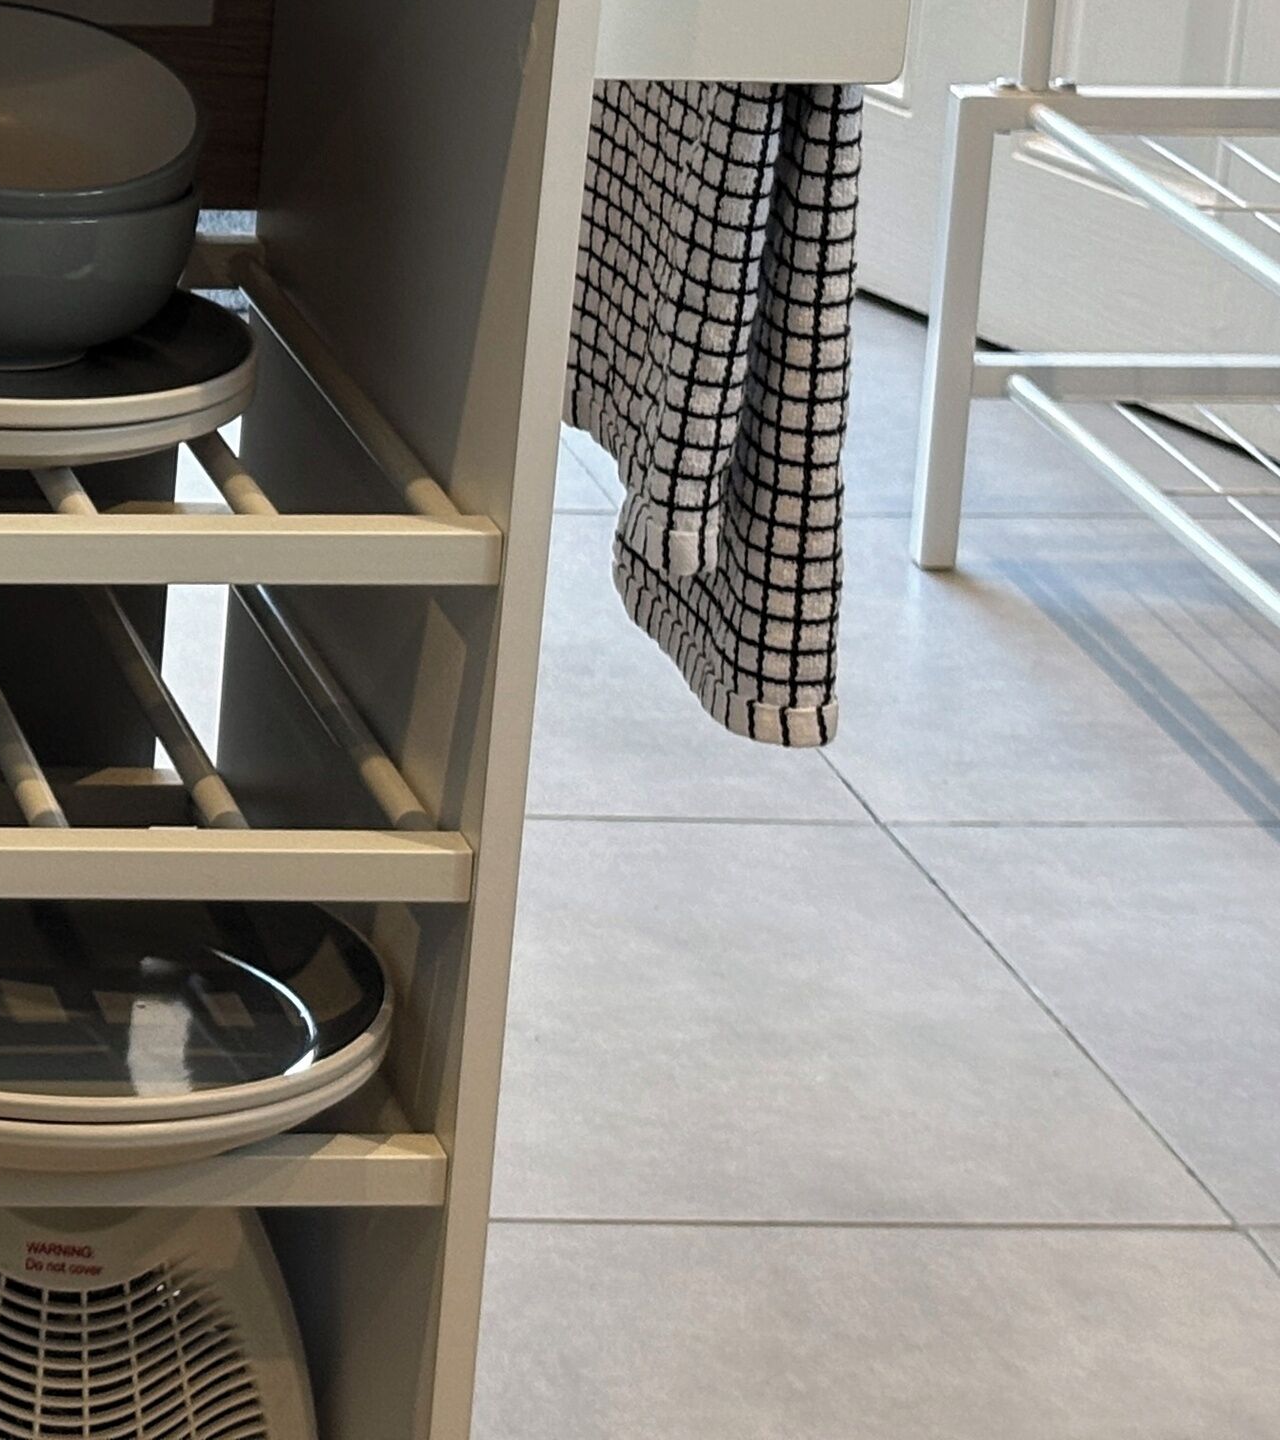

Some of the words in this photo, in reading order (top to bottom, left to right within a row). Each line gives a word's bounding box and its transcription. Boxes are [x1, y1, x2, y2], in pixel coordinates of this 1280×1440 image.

[25, 1257, 43, 1272] Do
[46, 1261, 66, 1274] not
[68, 1264, 104, 1276] cover
